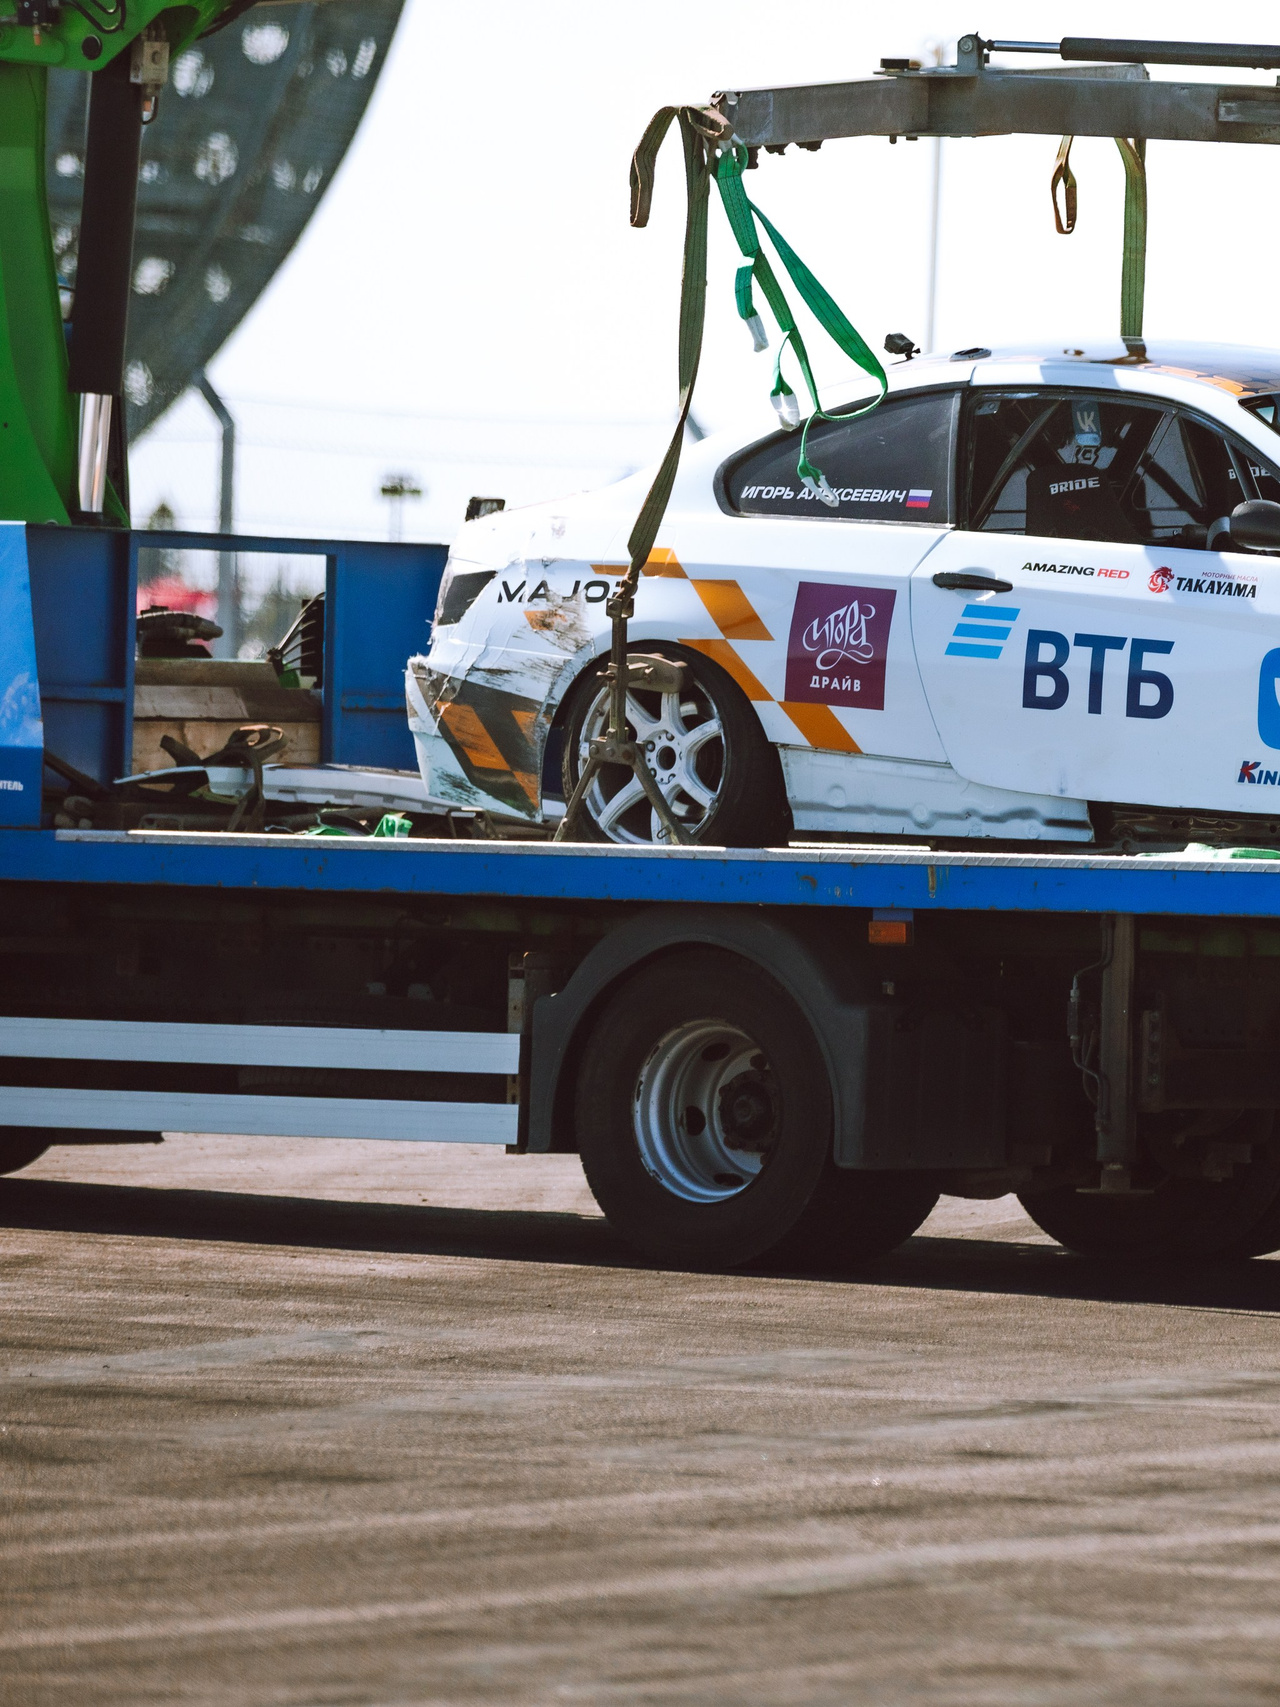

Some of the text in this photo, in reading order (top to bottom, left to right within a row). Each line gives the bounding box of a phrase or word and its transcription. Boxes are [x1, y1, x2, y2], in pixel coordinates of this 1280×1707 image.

[741, 485, 795, 500] ИГОРЬ
[1049, 477, 1100, 495] BRIDE
[1021, 562, 1130, 580] AMAZING RED
[1176, 577, 1257, 599] TAKAYAMA
[1022, 629, 1175, 719] ВТБ
[809, 675, 861, 692] ДРАЙВ
